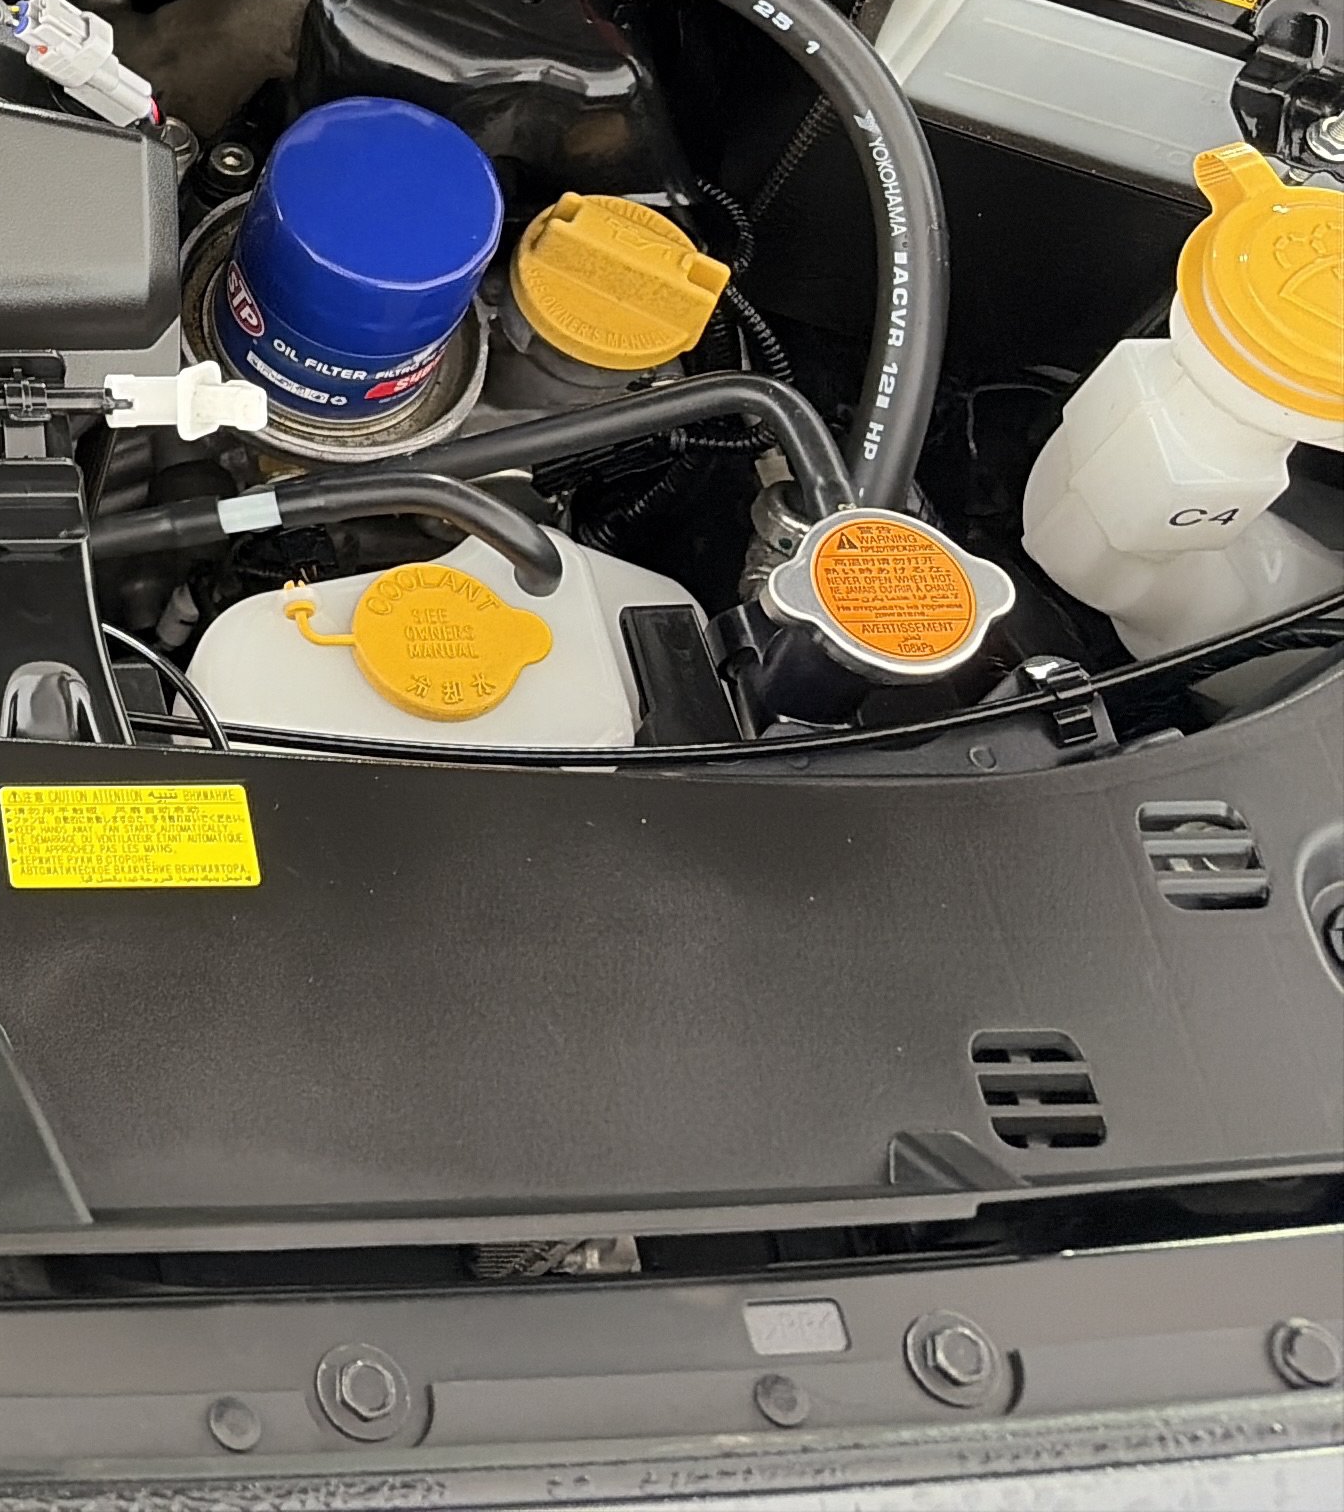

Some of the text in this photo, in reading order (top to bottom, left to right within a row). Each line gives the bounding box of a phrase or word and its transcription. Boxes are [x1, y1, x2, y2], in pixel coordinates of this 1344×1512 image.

[752, 0, 794, 31] 25
[867, 136, 908, 238] YOKOHAMA
[228, 271, 260, 328] STP
[887, 266, 908, 347] ACVR
[273, 339, 368, 380] OIL FILTER
[863, 421, 885, 461] HP
[1169, 508, 1239, 526] C4
[856, 534, 918, 545] WARNING
[367, 568, 499, 616] COOLANT
[827, 576, 861, 586] NEVER
[864, 576, 892, 585] OPEN
[896, 575, 928, 584] WHEN
[862, 623, 954, 634] AVERTISSEMENT
[408, 642, 479, 659] MANUAL
[48, 791, 87, 803] CAUTION
